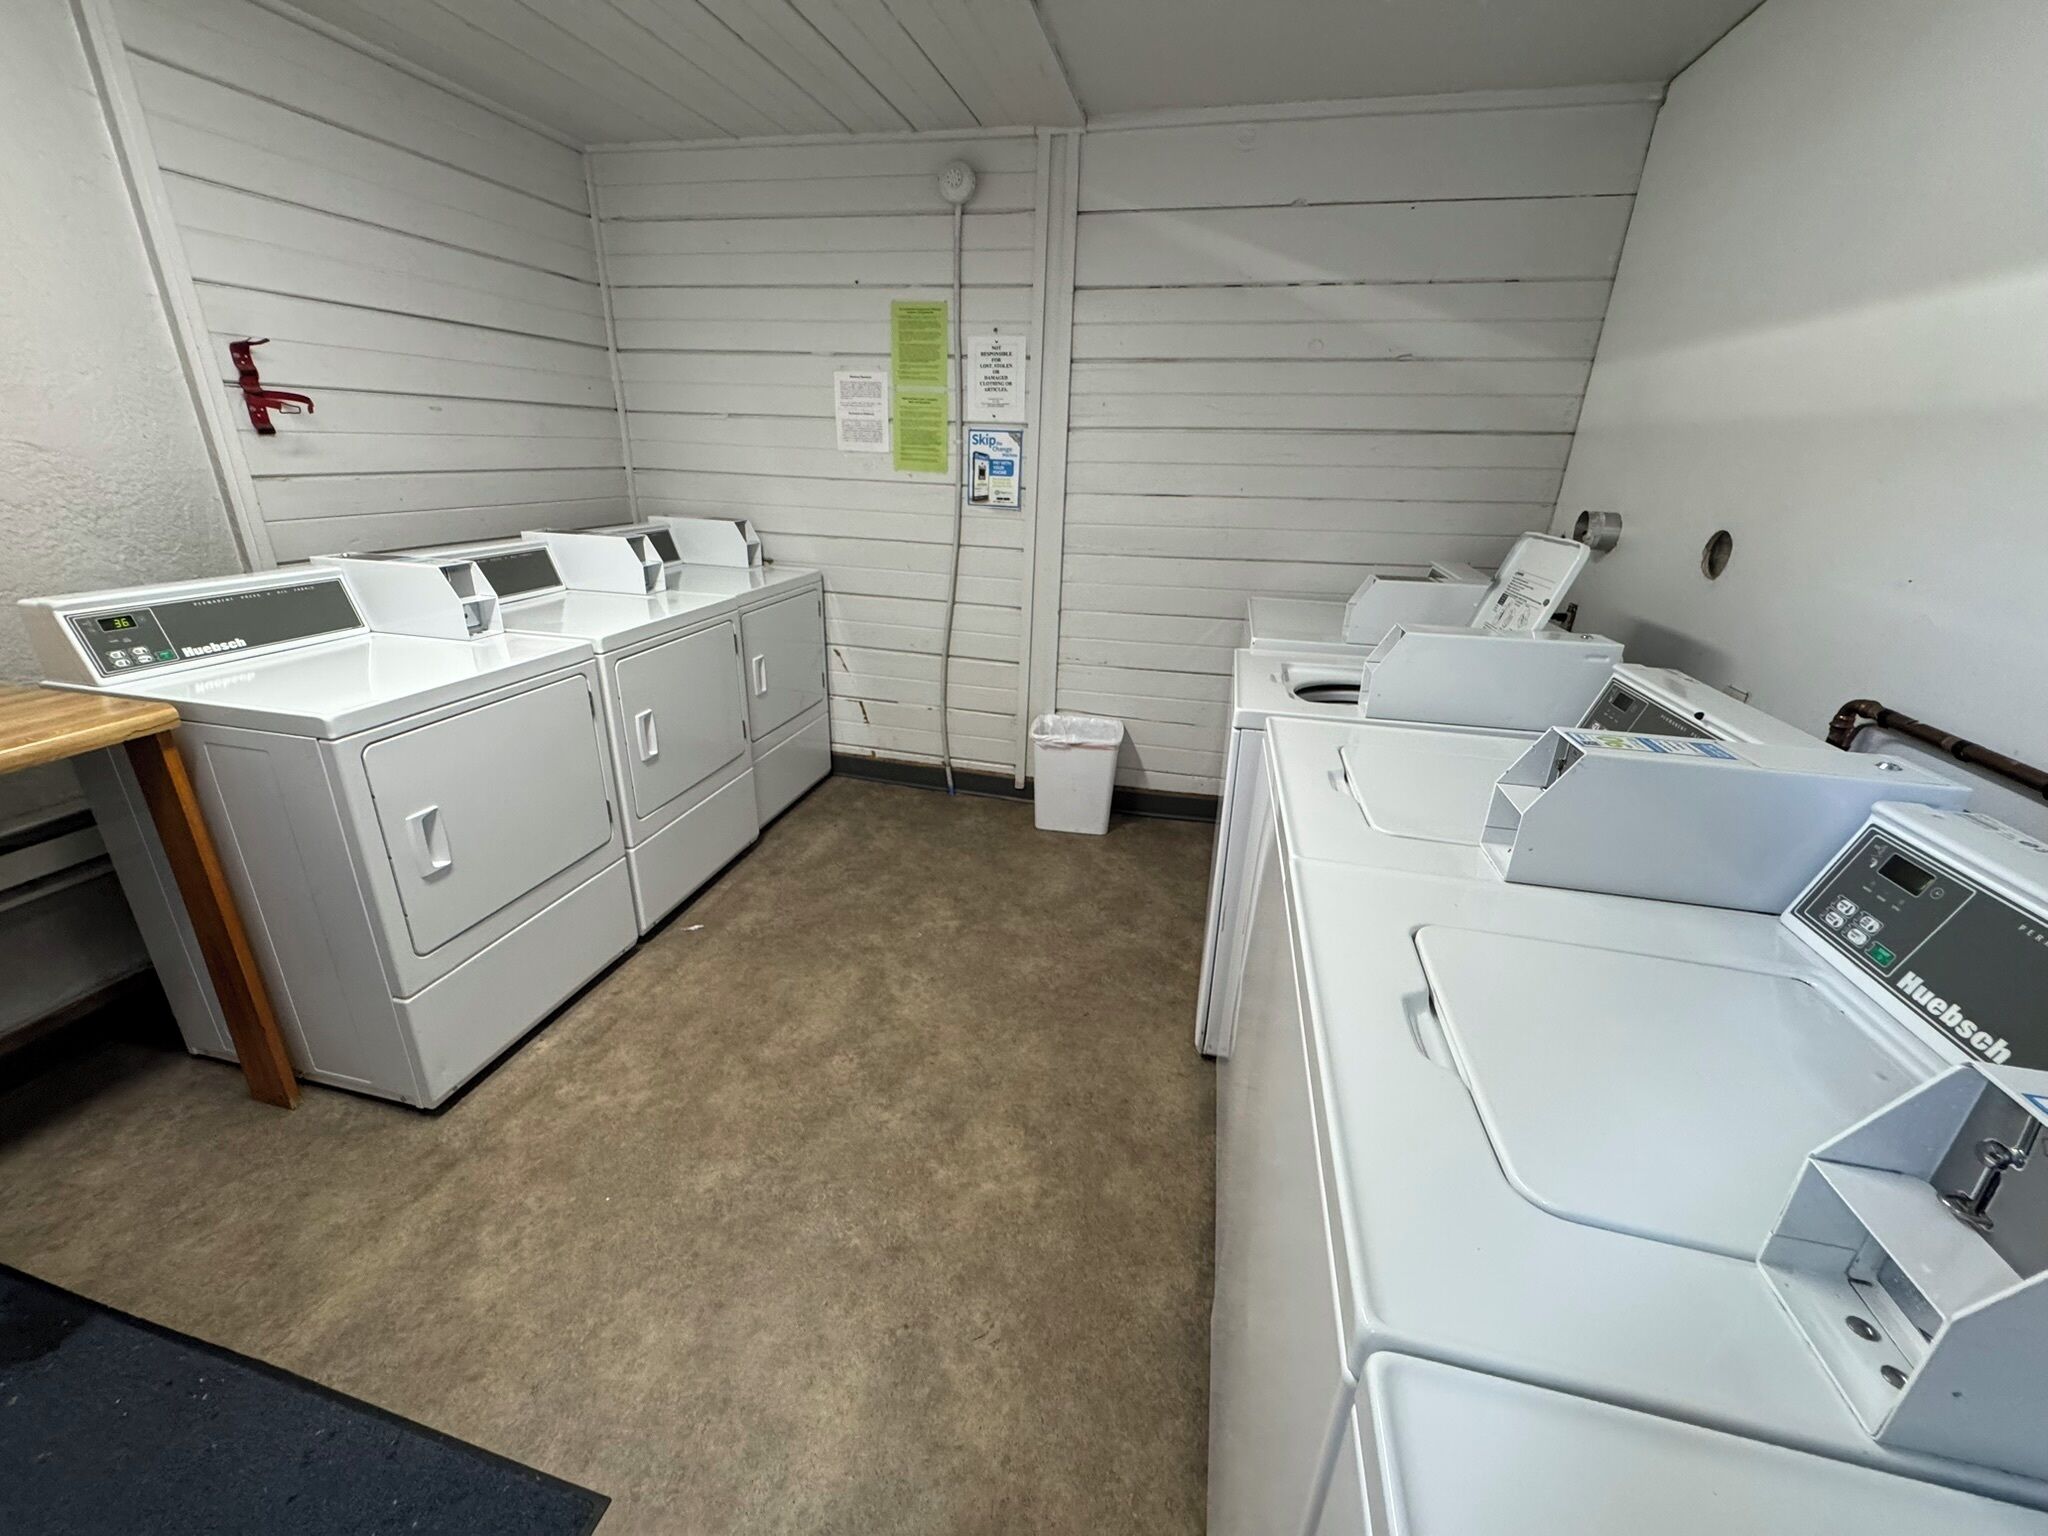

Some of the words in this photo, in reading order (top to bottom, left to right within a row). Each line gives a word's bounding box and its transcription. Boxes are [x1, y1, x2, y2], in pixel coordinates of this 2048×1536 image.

[972, 433, 996, 448] Skip
[114, 617, 130, 629] 36
[181, 637, 247, 658] Huebsch
[1896, 971, 2012, 1065] Huebsch
